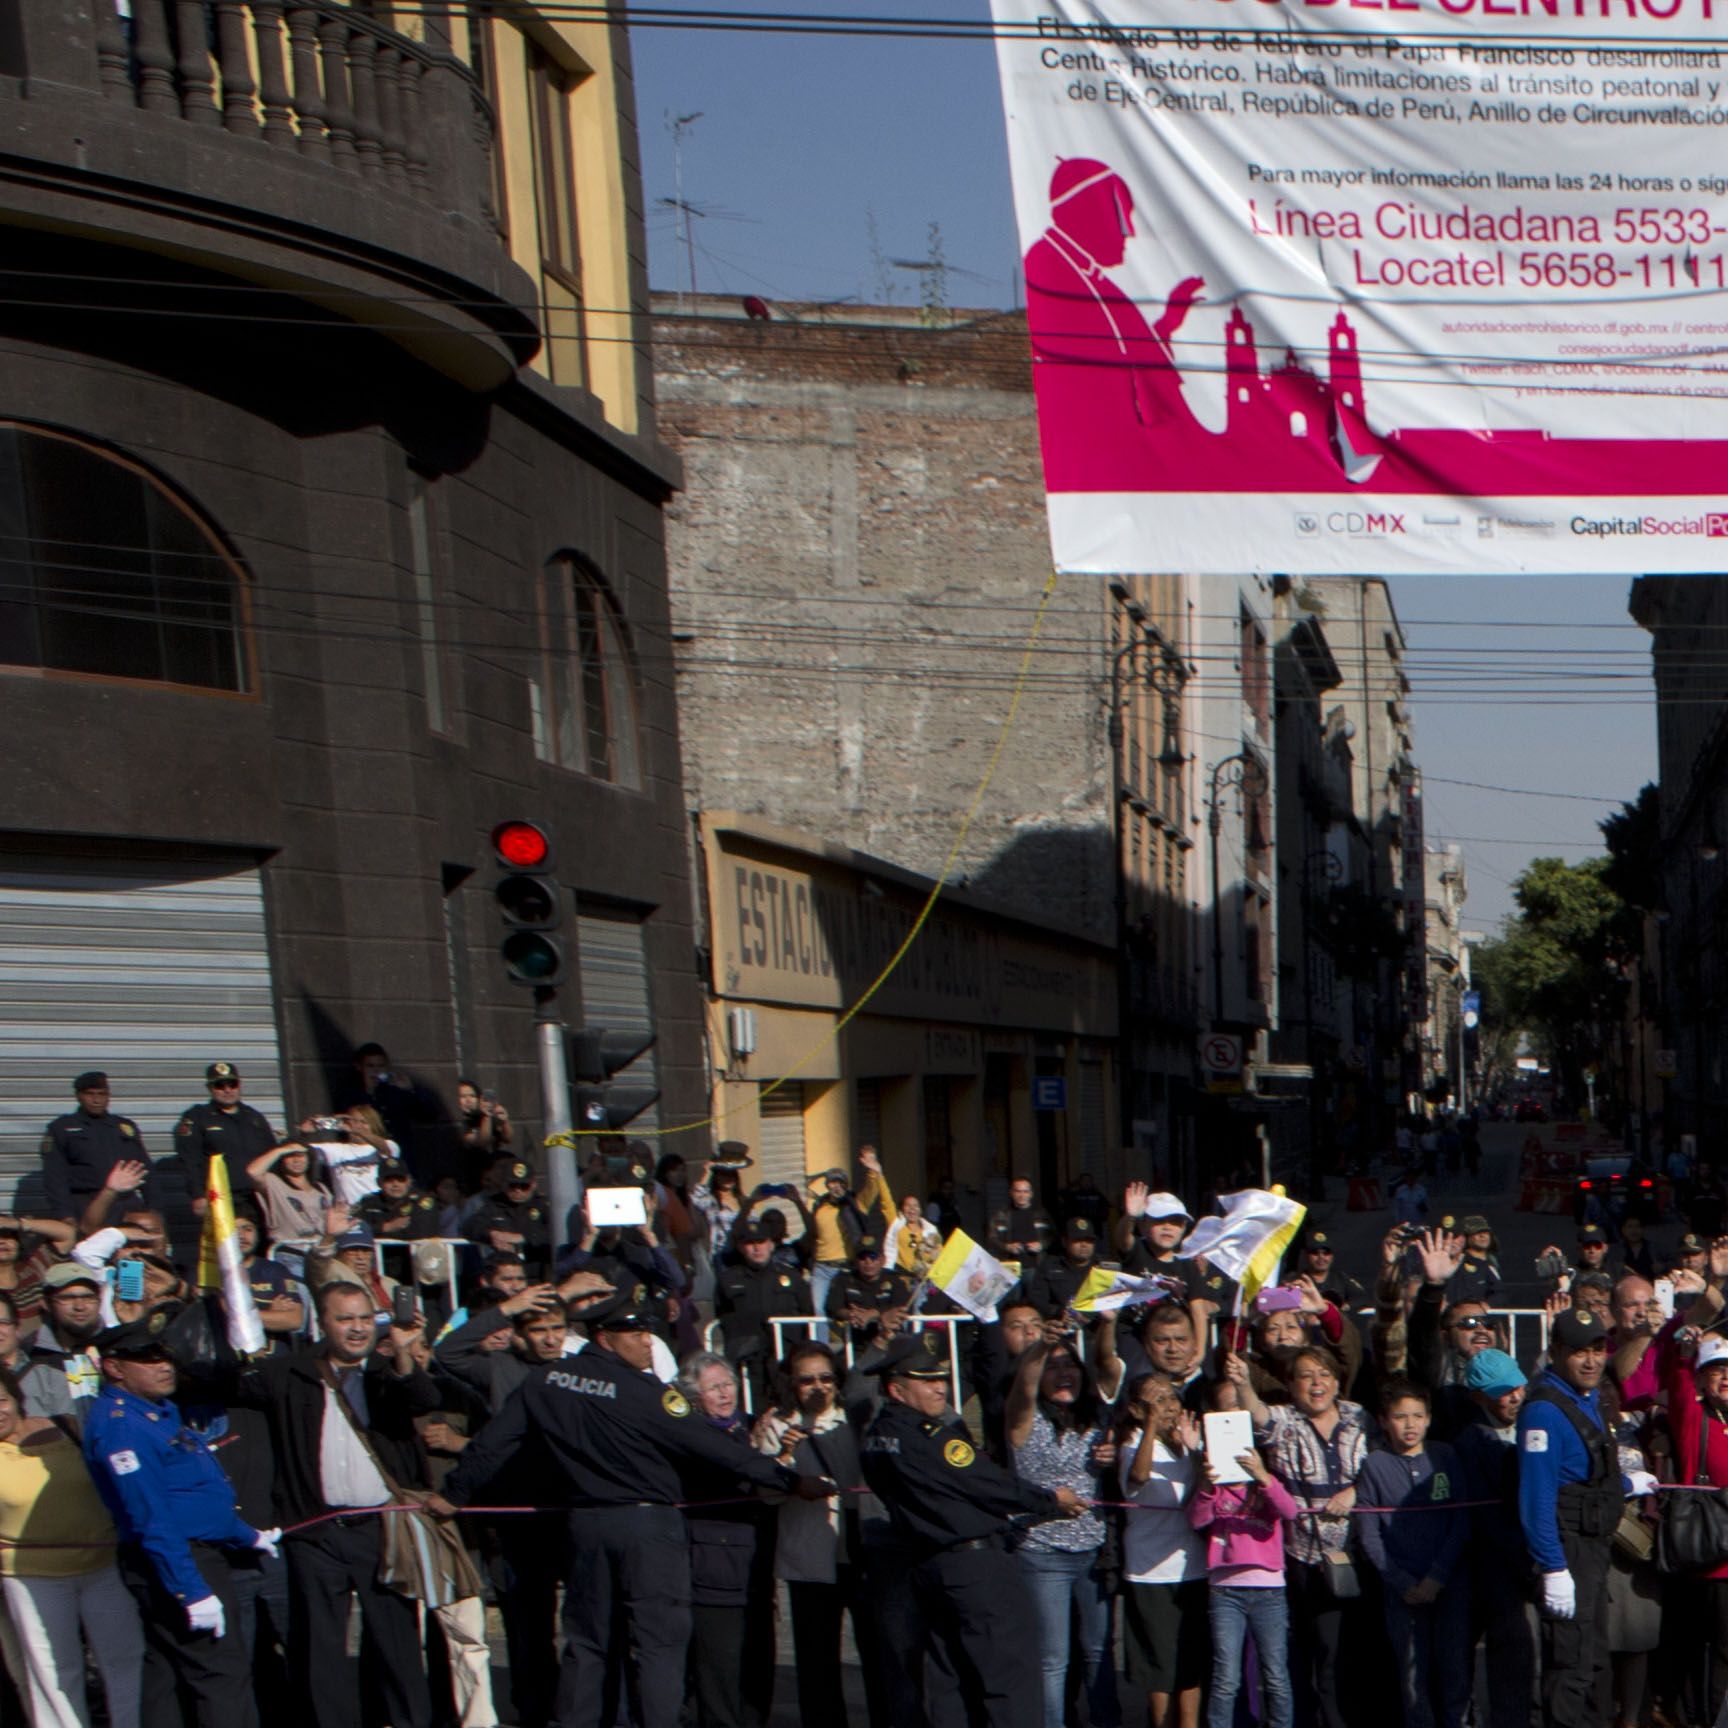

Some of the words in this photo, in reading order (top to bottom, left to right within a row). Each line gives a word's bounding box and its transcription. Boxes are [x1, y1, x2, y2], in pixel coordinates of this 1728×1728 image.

[1212, 30, 1241, 52] de
[1254, 32, 1342, 58] febrero
[1354, 36, 1373, 59] el
[1386, 39, 1446, 65] Papa
[1458, 43, 1575, 67] Francisco
[1587, 46, 1720, 69] desarrollará
[1131, 56, 1247, 84] Histórico.
[1255, 61, 1327, 88] Habrá
[1334, 65, 1471, 94] limitaciones
[1480, 72, 1498, 94] al
[1508, 73, 1594, 96] tránsito
[1602, 75, 1700, 102] peatonal
[1708, 80, 1720, 102] y
[1067, 80, 1098, 102] de
[1145, 88, 1234, 115] Central,
[1243, 91, 1359, 120] República
[1366, 97, 1394, 119] de
[1402, 97, 1463, 124] Perú,
[1469, 101, 1531, 123] Anillo
[1538, 103, 1566, 124] de
[1248, 163, 1295, 184] Para
[1301, 169, 1365, 191] mayor
[1371, 167, 1492, 190] información
[1497, 171, 1551, 190] llama
[1555, 172, 1584, 191] las
[1589, 172, 1613, 191] 24
[1618, 173, 1674, 192] horas
[1680, 177, 1692, 192] o
[1250, 200, 1362, 240] Línea
[1375, 202, 1601, 244] Ciudadana
[1353, 248, 1505, 287] Locatel
[1518, 252, 1726, 289] 5658-1111
[1327, 512, 1406, 534] CDMX
[1571, 515, 1703, 538] CapitalSocial
[545, 1370, 616, 1399] POLICIA
